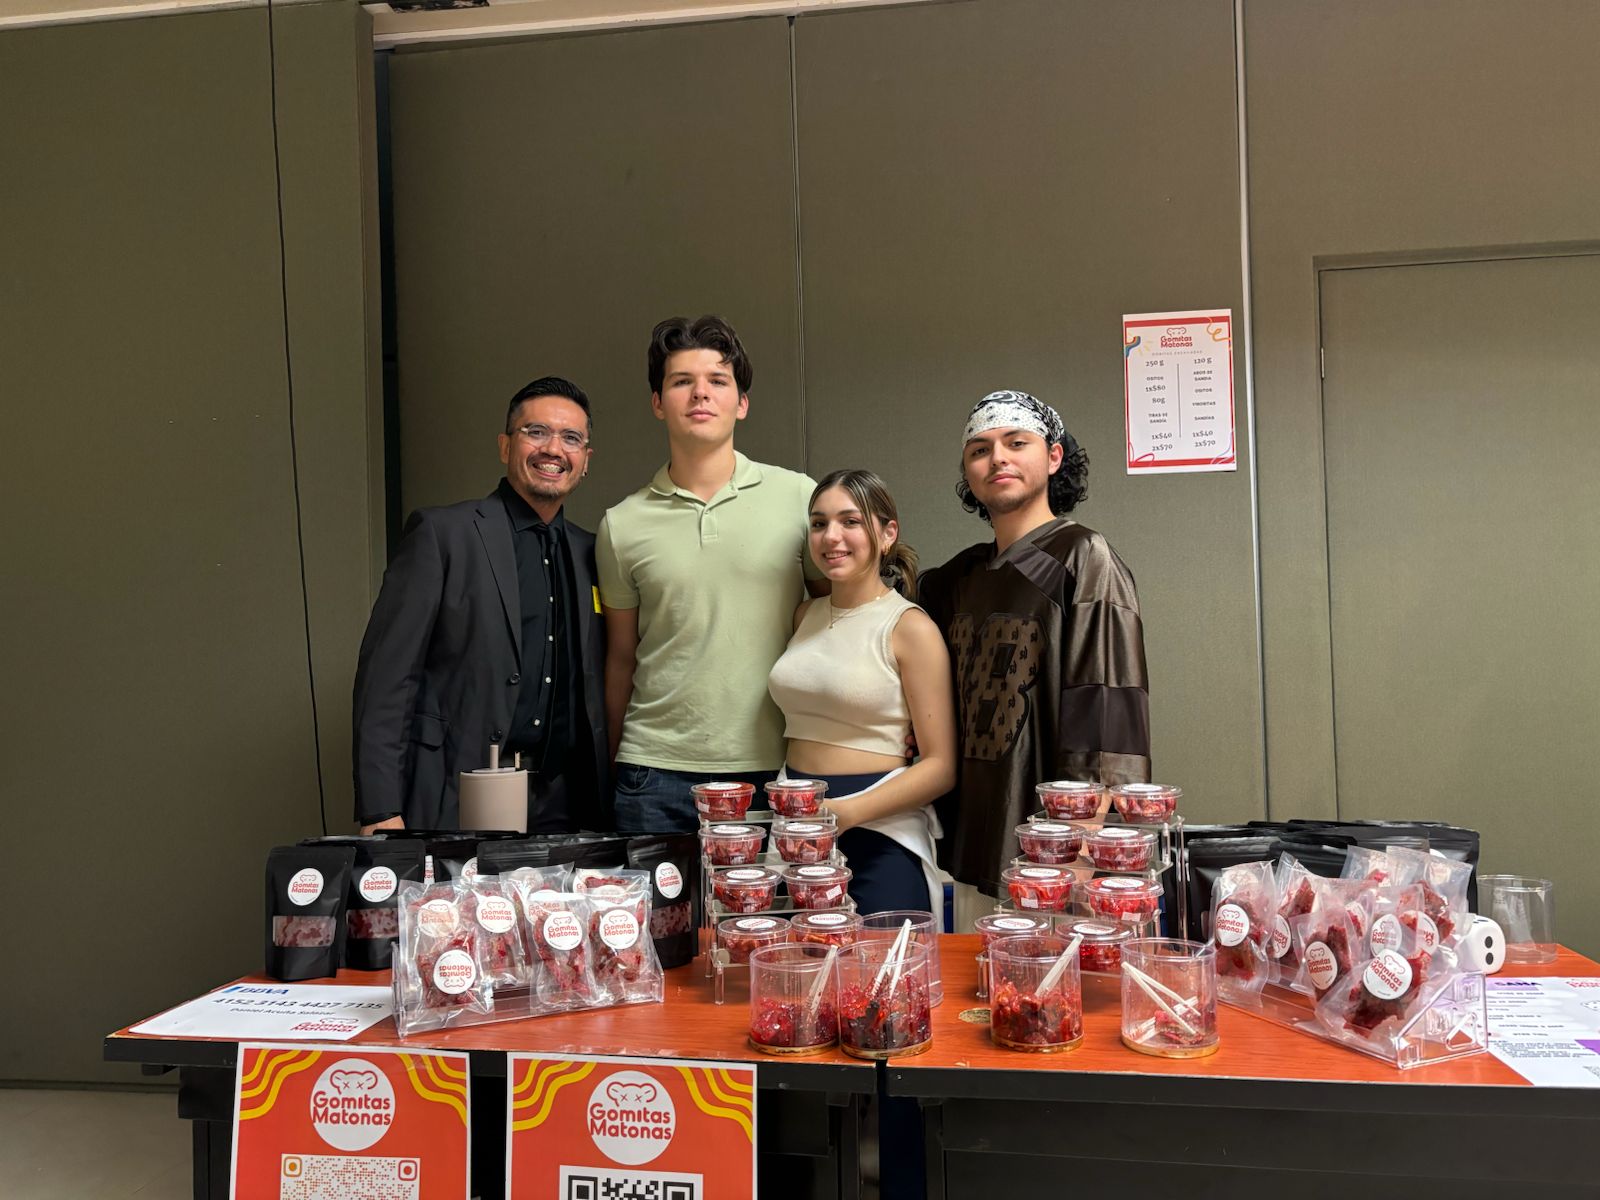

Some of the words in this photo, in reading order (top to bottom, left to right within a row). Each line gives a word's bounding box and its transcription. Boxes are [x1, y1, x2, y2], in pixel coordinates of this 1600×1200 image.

[659, 880, 680, 888] Matonas
[548, 925, 578, 933] Gomitas
[603, 923, 634, 931] Gomitas
[548, 930, 579, 939] Matonas
[603, 928, 635, 936] Matonas
[439, 964, 472, 972] Matonas
[439, 971, 472, 979] Gomitas
[313, 1090, 391, 1110] Gomitas
[313, 1107, 391, 1126] Matonas
[590, 1103, 670, 1124] Gomitas
[590, 1119, 672, 1140] Matonas
